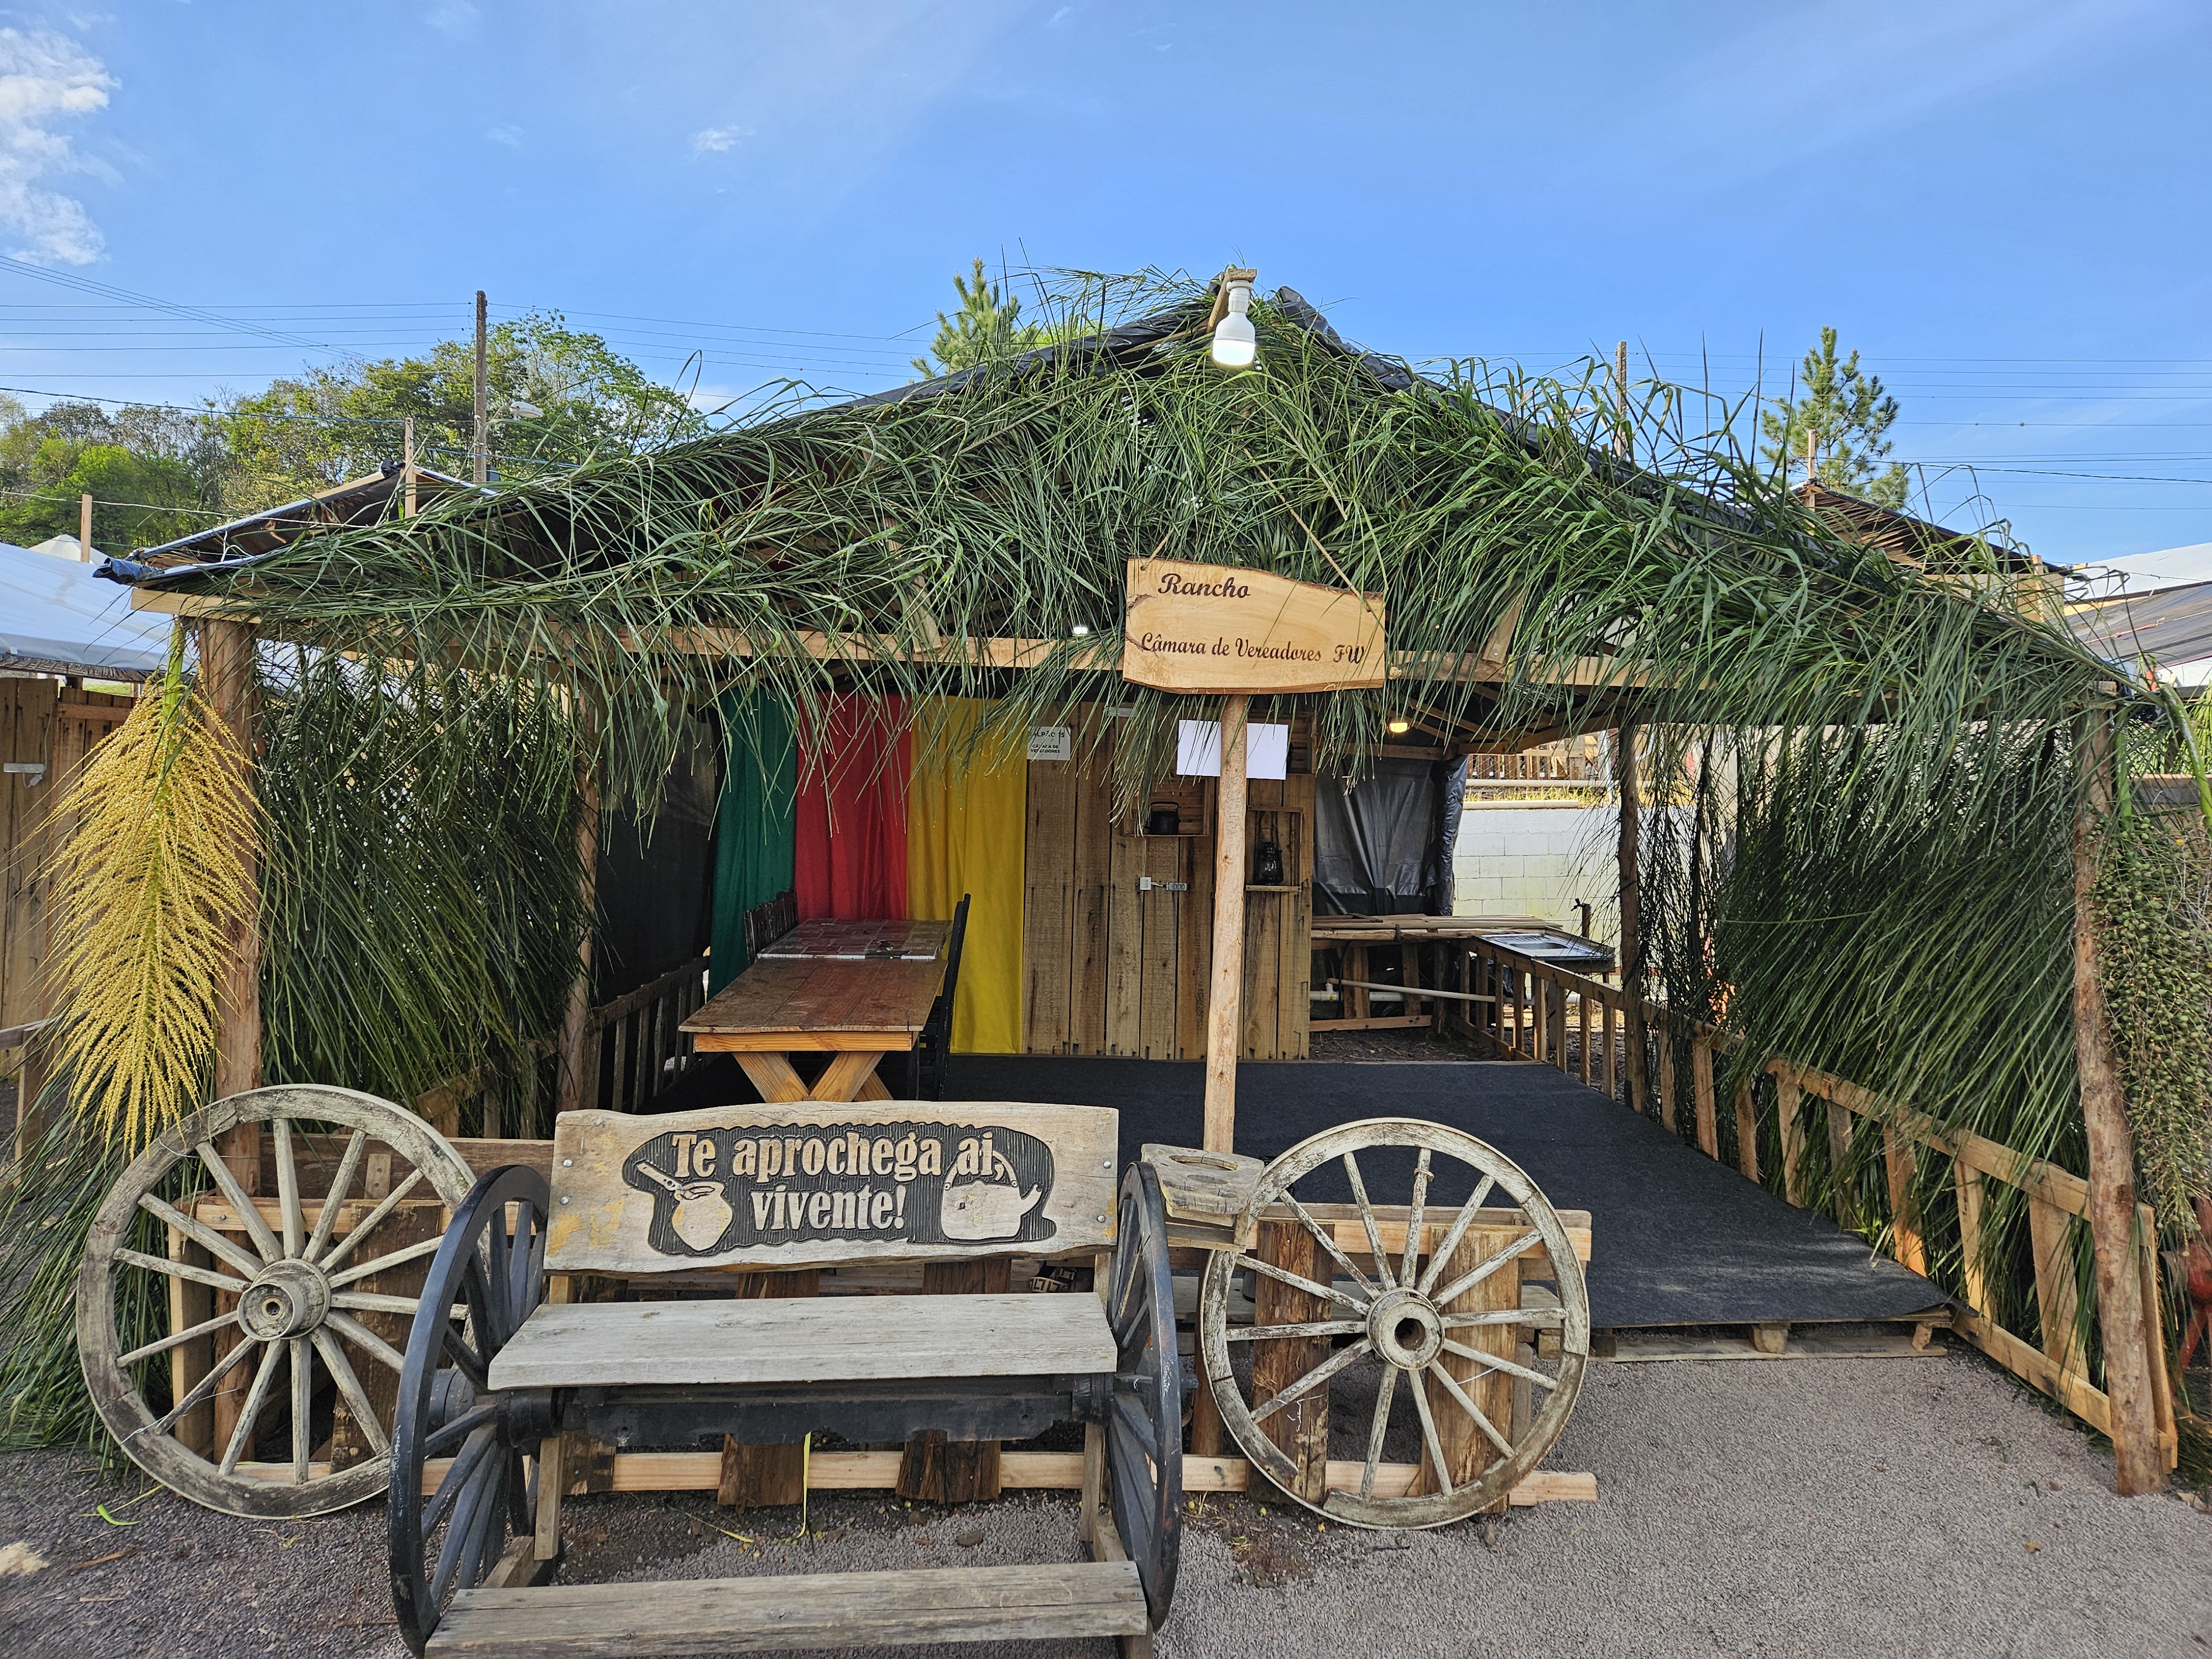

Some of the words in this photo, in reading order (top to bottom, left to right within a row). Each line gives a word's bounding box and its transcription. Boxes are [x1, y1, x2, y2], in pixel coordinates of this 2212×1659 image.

[1157, 573, 1251, 598] Rancho
[1141, 632, 1207, 654] Câmara
[1211, 637, 1230, 656] de
[1235, 638, 1322, 661] Vereadores
[1333, 644, 1365, 664] FW
[672, 1134, 716, 1177] Te
[732, 1131, 941, 1183] aprochega
[750, 1185, 906, 1230] vivente!
